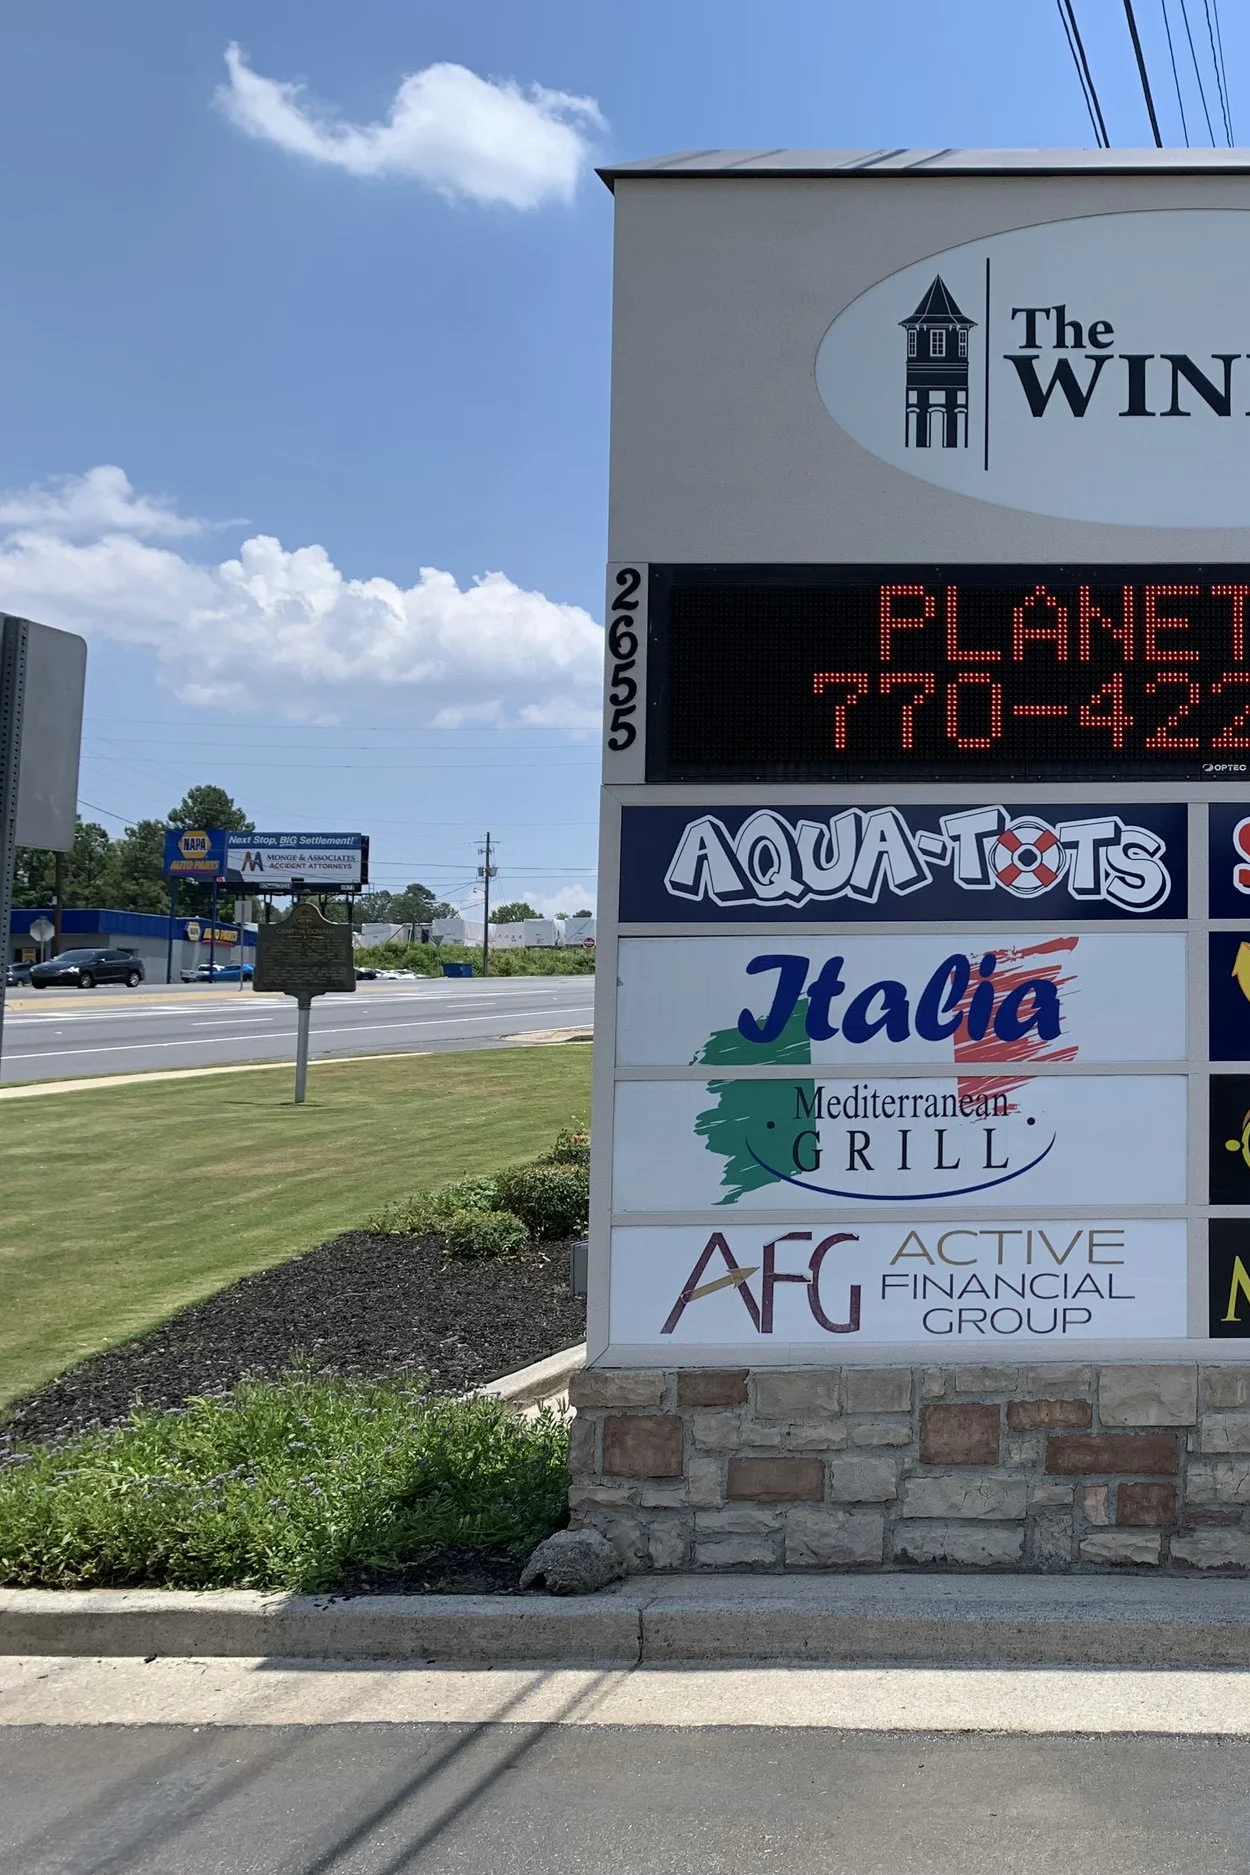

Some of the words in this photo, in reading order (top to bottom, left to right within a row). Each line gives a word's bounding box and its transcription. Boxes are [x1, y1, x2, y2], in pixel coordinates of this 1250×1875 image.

[1011, 304, 1114, 350] The
[607, 567, 642, 752] 2655
[1214, 763, 1247, 772] OPTEC
[183, 838, 206, 851] NAPA
[229, 836, 251, 845] Next
[252, 836, 277, 846] Stop,
[279, 836, 297, 845] BIG
[267, 853, 298, 861] MONGE
[308, 854, 356, 862] ASSOCIATES
[664, 804, 1171, 913] AQUA-TOTS
[738, 953, 1061, 1044] Italia
[793, 1085, 1009, 1121] Mediterranean
[792, 1128, 1009, 1172] GRILL
[889, 1229, 1125, 1265] ACTIVE
[660, 1231, 860, 1334] AFG
[881, 1273, 1135, 1300] FINANCIAL
[922, 1307, 1092, 1334] GROUP
